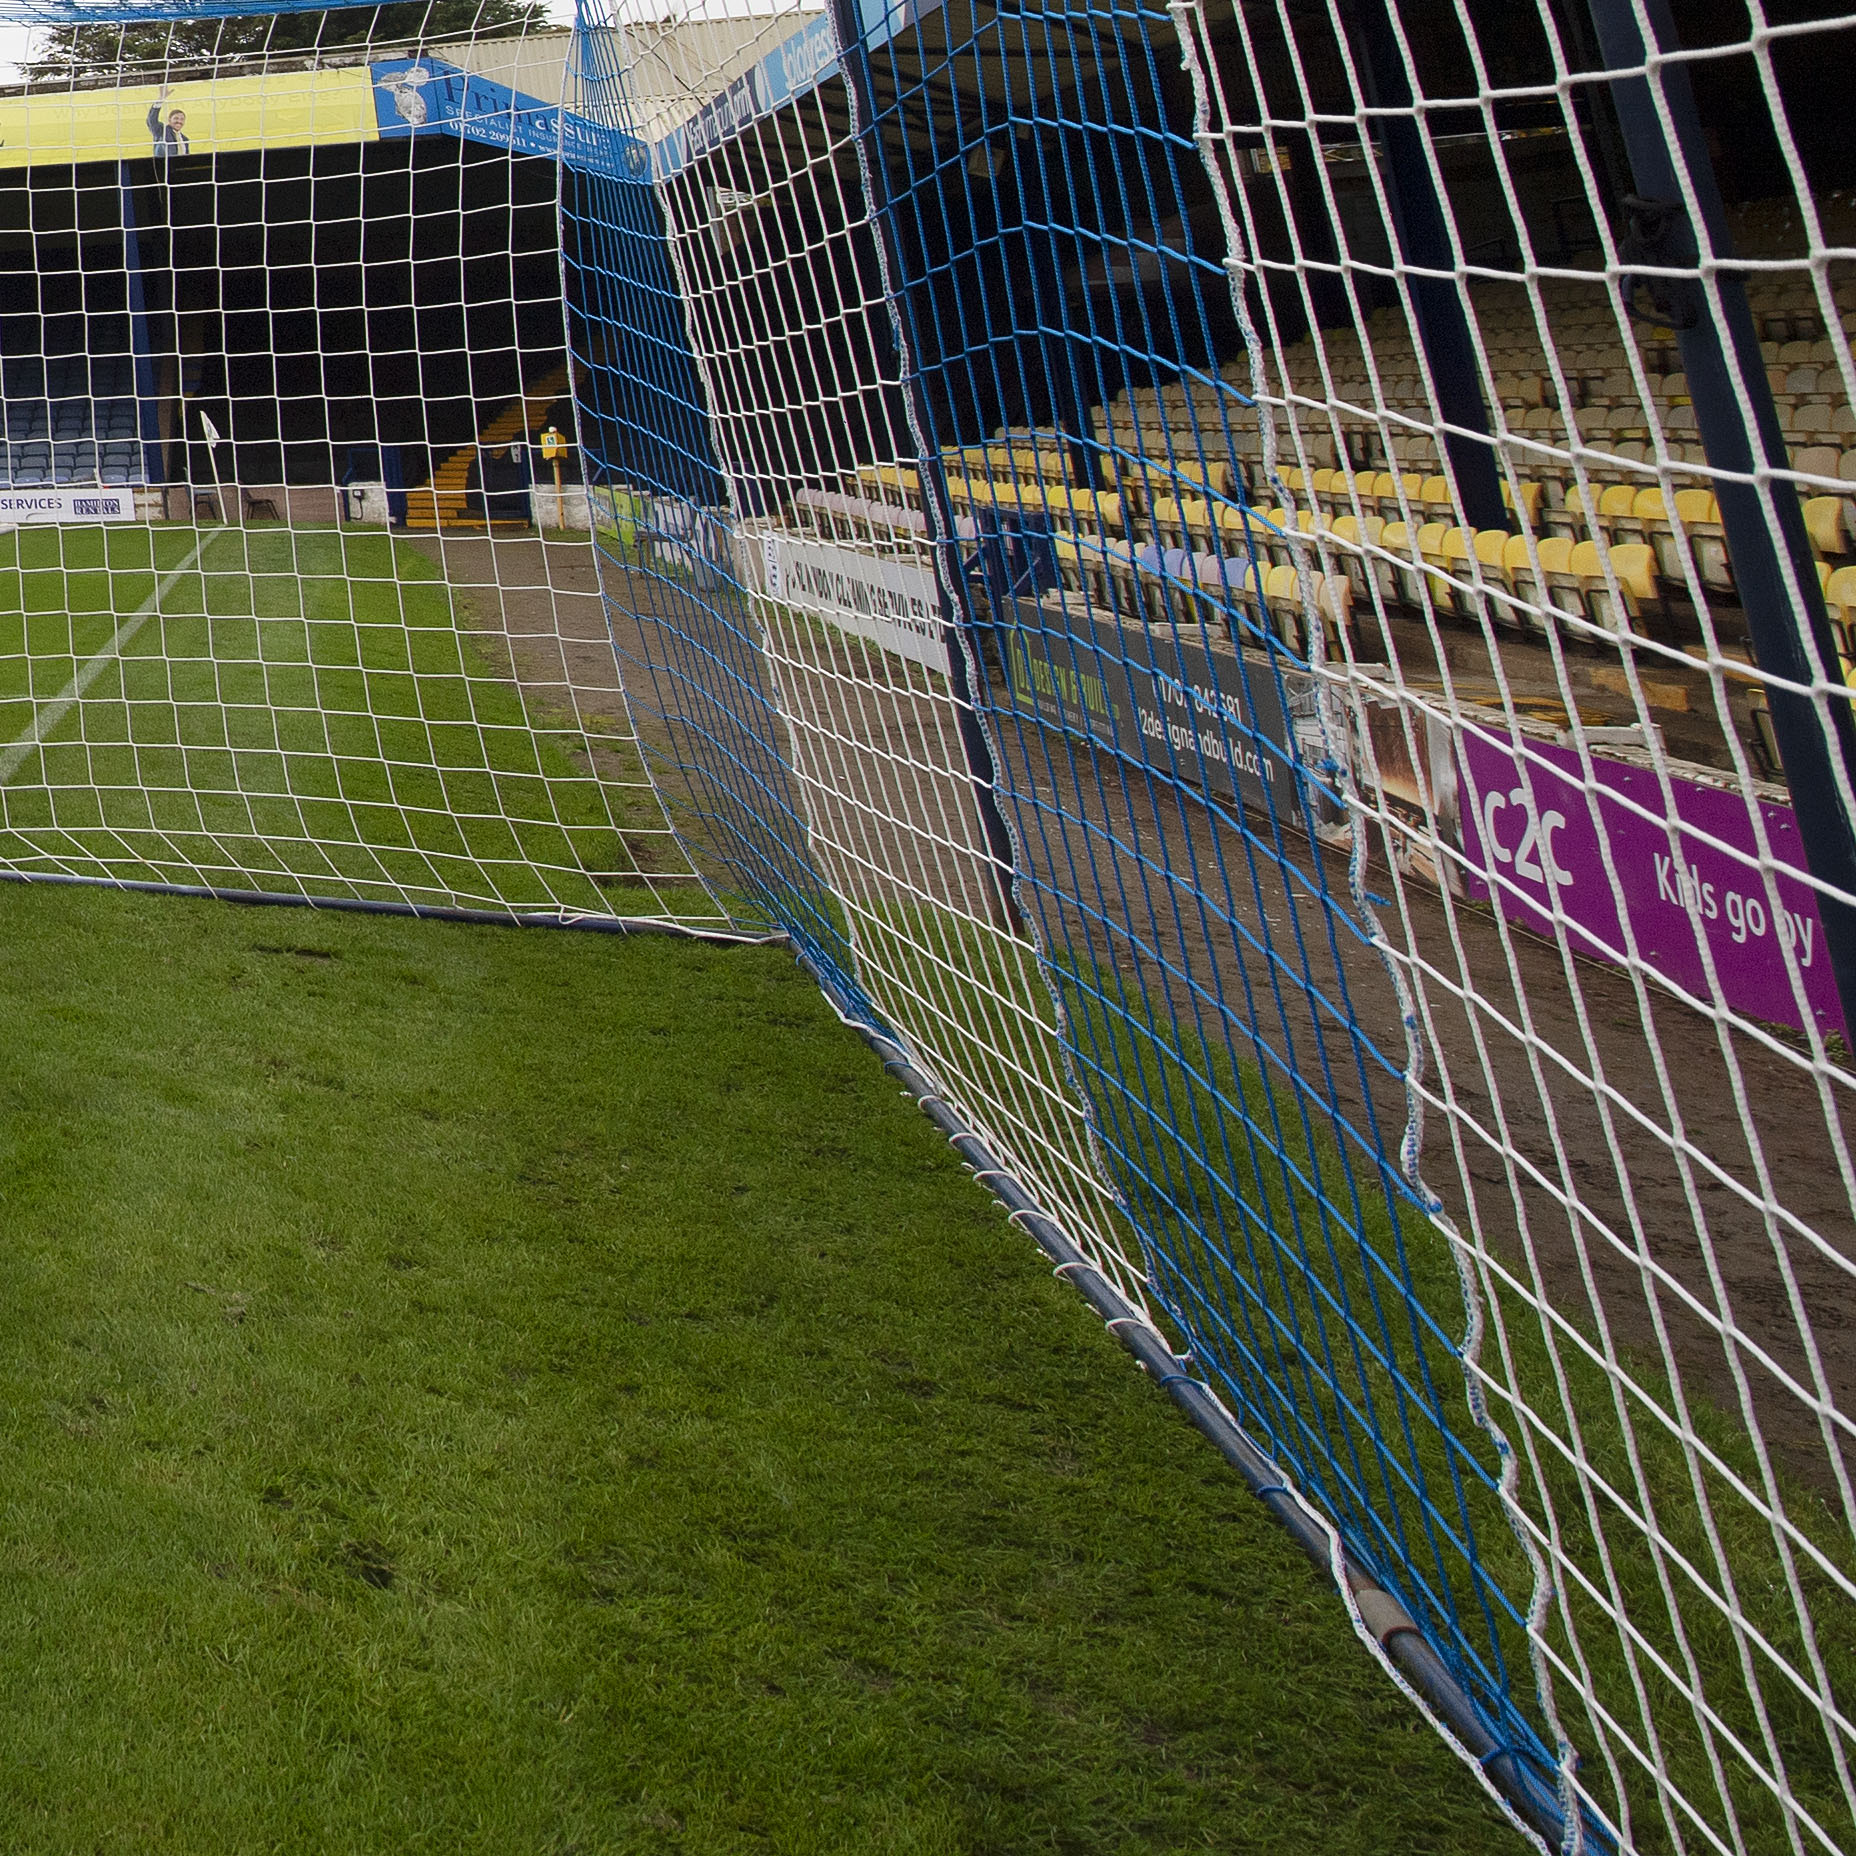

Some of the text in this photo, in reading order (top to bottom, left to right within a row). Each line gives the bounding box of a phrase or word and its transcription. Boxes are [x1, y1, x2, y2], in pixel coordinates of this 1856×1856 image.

[1, 497, 63, 510] SERVICES
[1485, 788, 1574, 886] c2c
[1725, 890, 1766, 944] go
